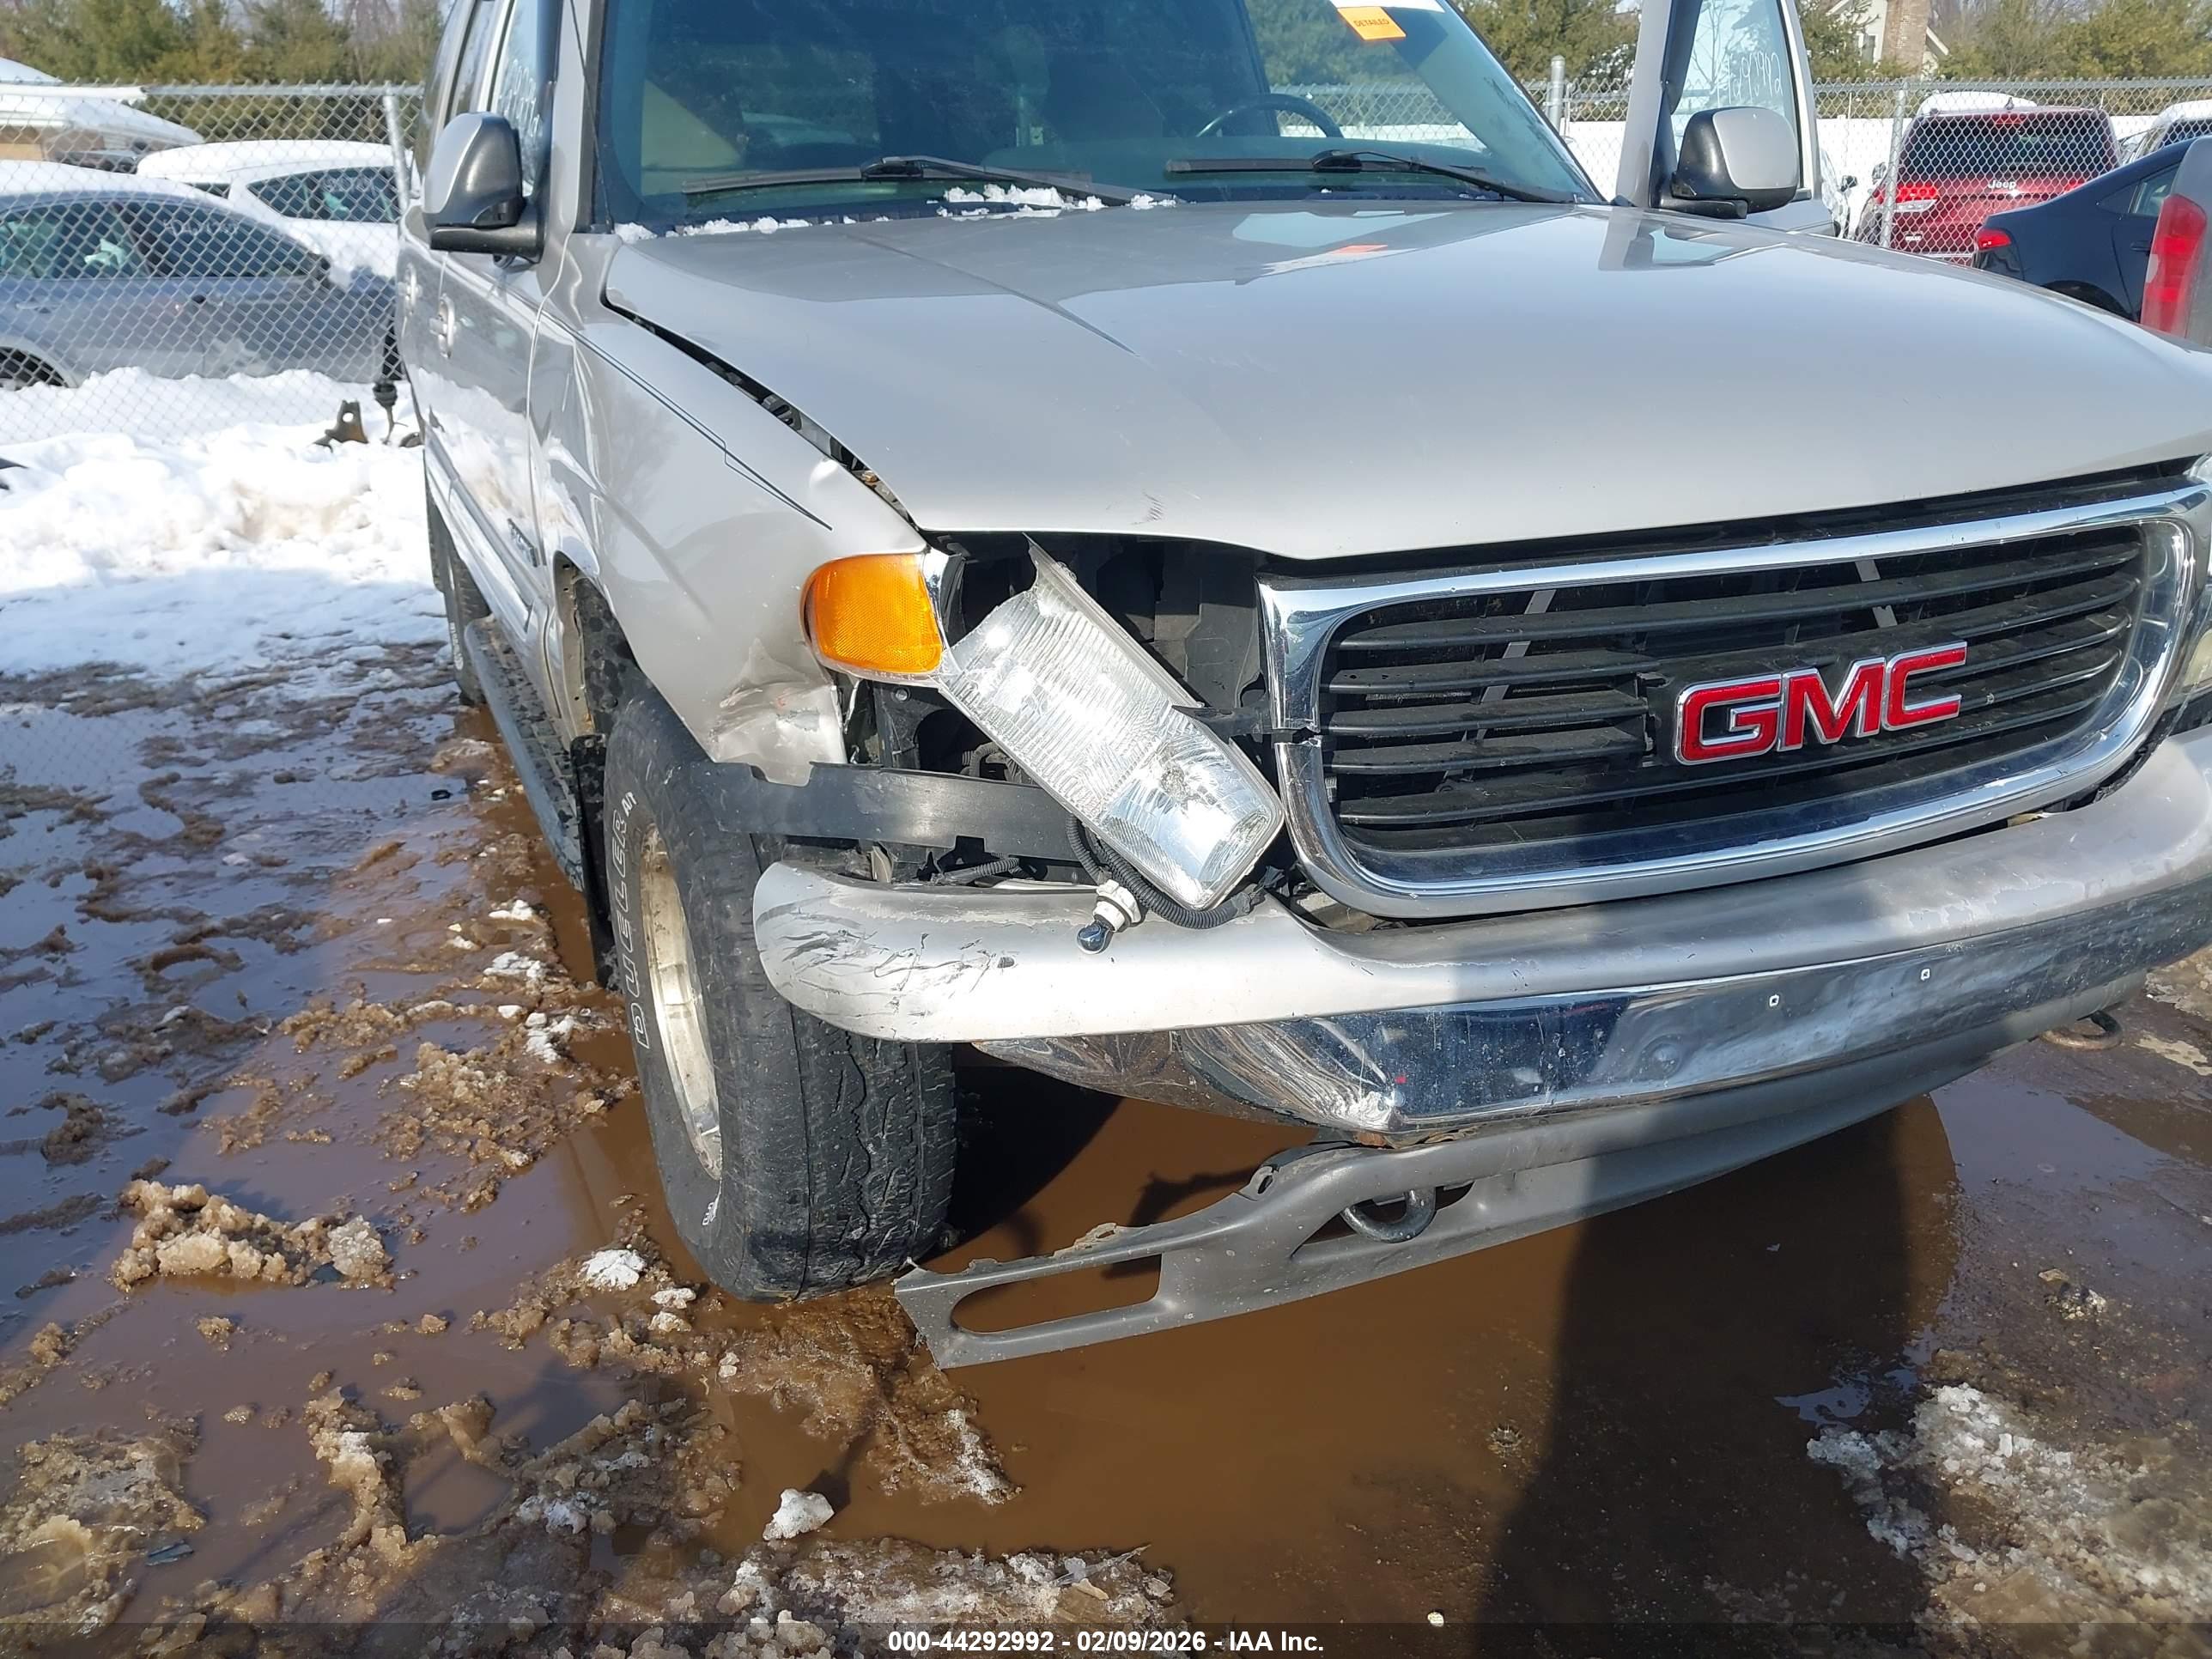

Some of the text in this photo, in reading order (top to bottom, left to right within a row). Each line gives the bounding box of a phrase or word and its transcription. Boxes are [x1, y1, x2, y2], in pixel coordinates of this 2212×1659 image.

[1352, 18, 1390, 27] DETAILED
[1987, 179, 2017, 191] Jeep
[1674, 641, 1967, 765] GMC
[611, 809, 649, 1049] DUELER
